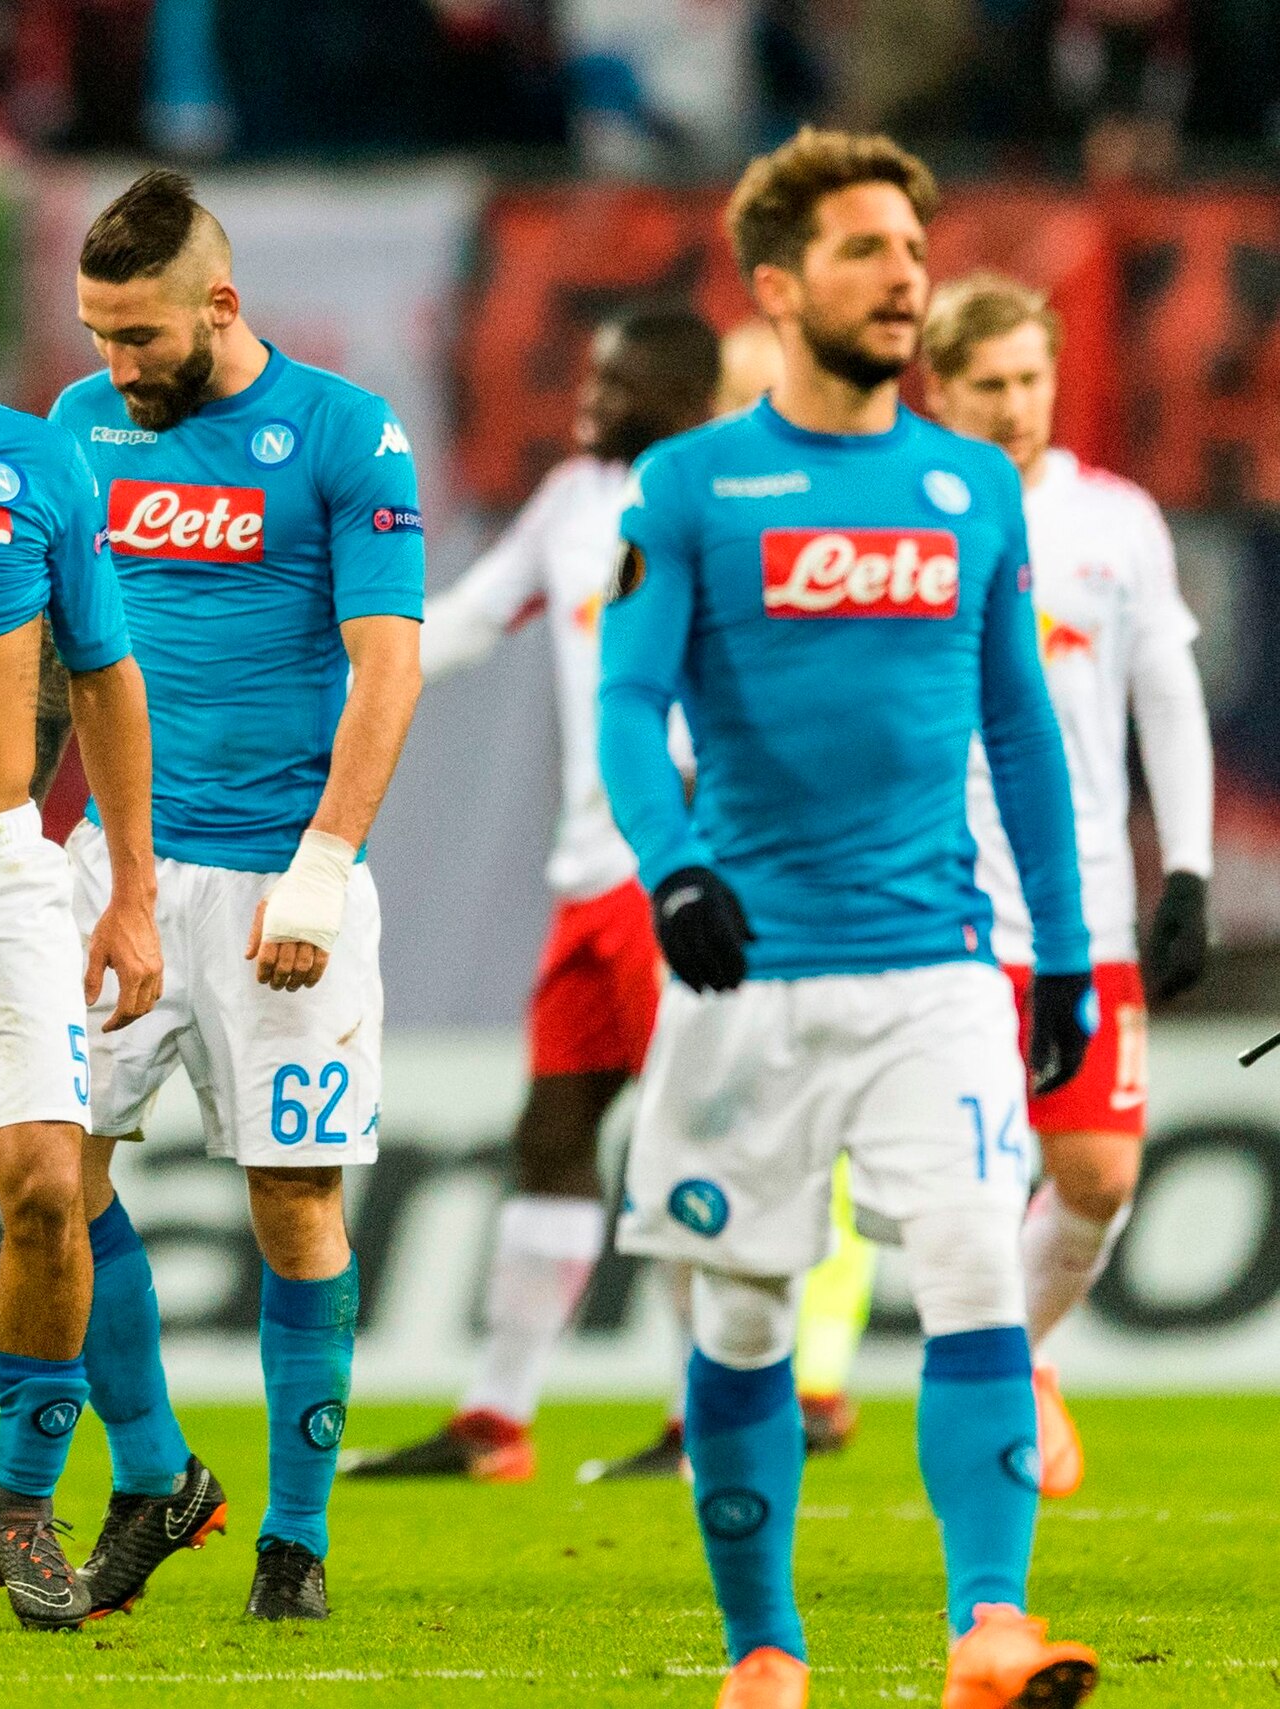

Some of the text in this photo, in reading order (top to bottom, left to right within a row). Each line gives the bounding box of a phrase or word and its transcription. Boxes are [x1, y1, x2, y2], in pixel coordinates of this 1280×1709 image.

[91, 426, 158, 445] Kappa
[261, 431, 287, 456] N
[108, 490, 263, 551] Lete
[764, 534, 958, 612] Lete
[67, 1023, 89, 1106] 5
[271, 1060, 349, 1145] 62
[956, 1094, 1025, 1182] 14
[51, 1409, 70, 1427] N
[321, 1413, 336, 1436] N
